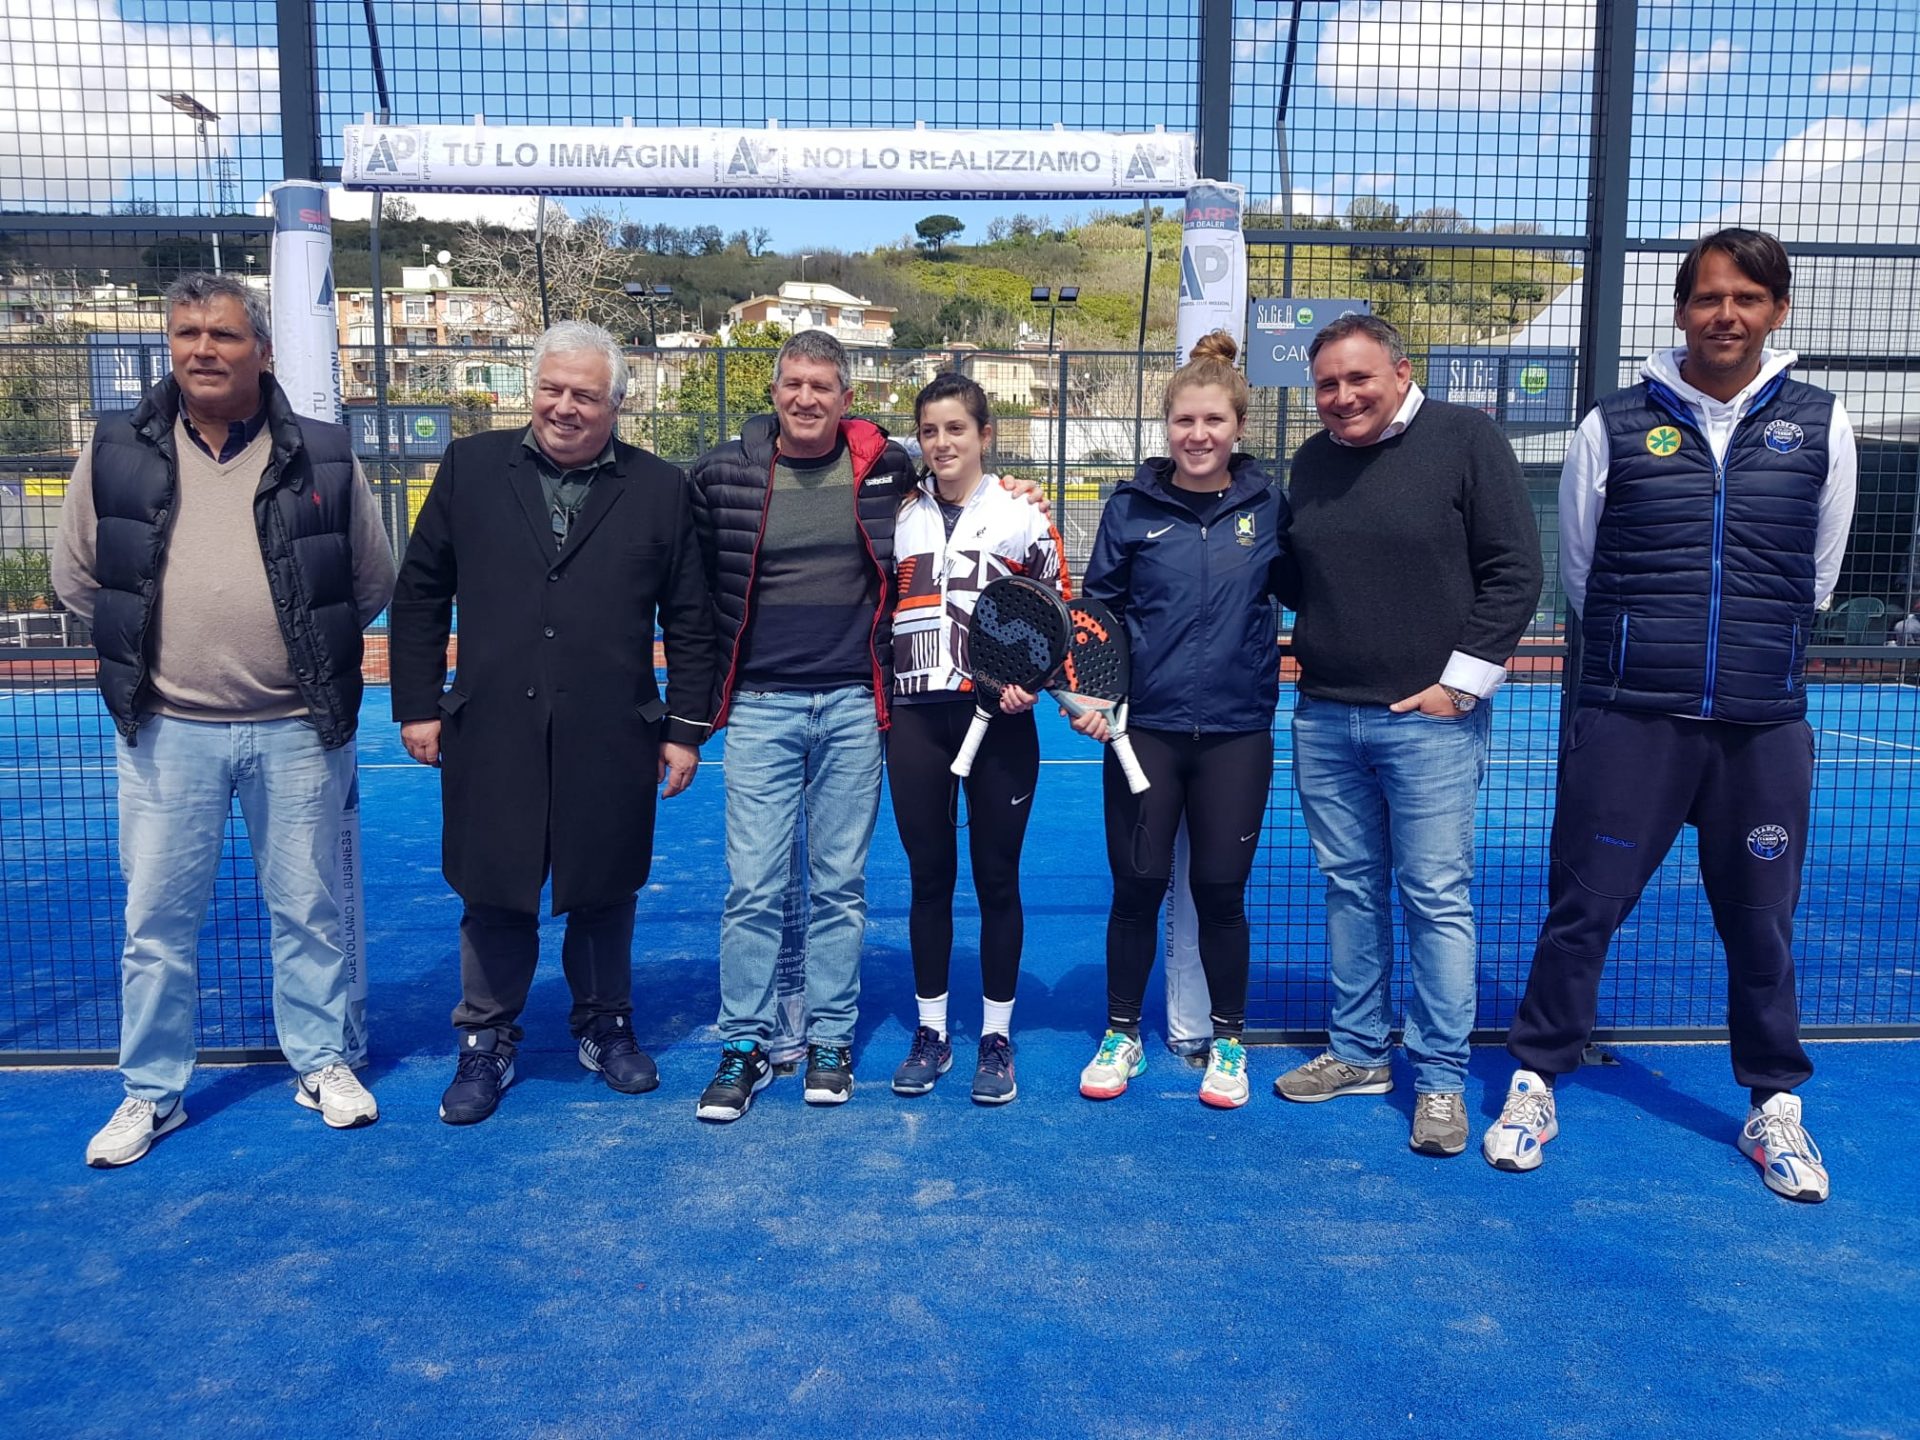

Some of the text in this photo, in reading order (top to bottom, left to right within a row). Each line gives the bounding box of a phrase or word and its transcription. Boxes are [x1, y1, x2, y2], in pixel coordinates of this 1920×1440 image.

[443, 142, 700, 169] TU LO IMMAGINI
[802, 147, 1101, 173] NOI LO REALIZZIAMO
[844, 189, 944, 200] BUSINESS
[1185, 207, 1235, 222] ARP
[308, 223, 330, 231] PARTN
[1272, 345, 1310, 362] CAM
[313, 392, 327, 413] TU
[341, 829, 354, 890] BUSINESS
[1167, 895, 1175, 917] TUA
[345, 909, 357, 984] AGEVOLIAMO
